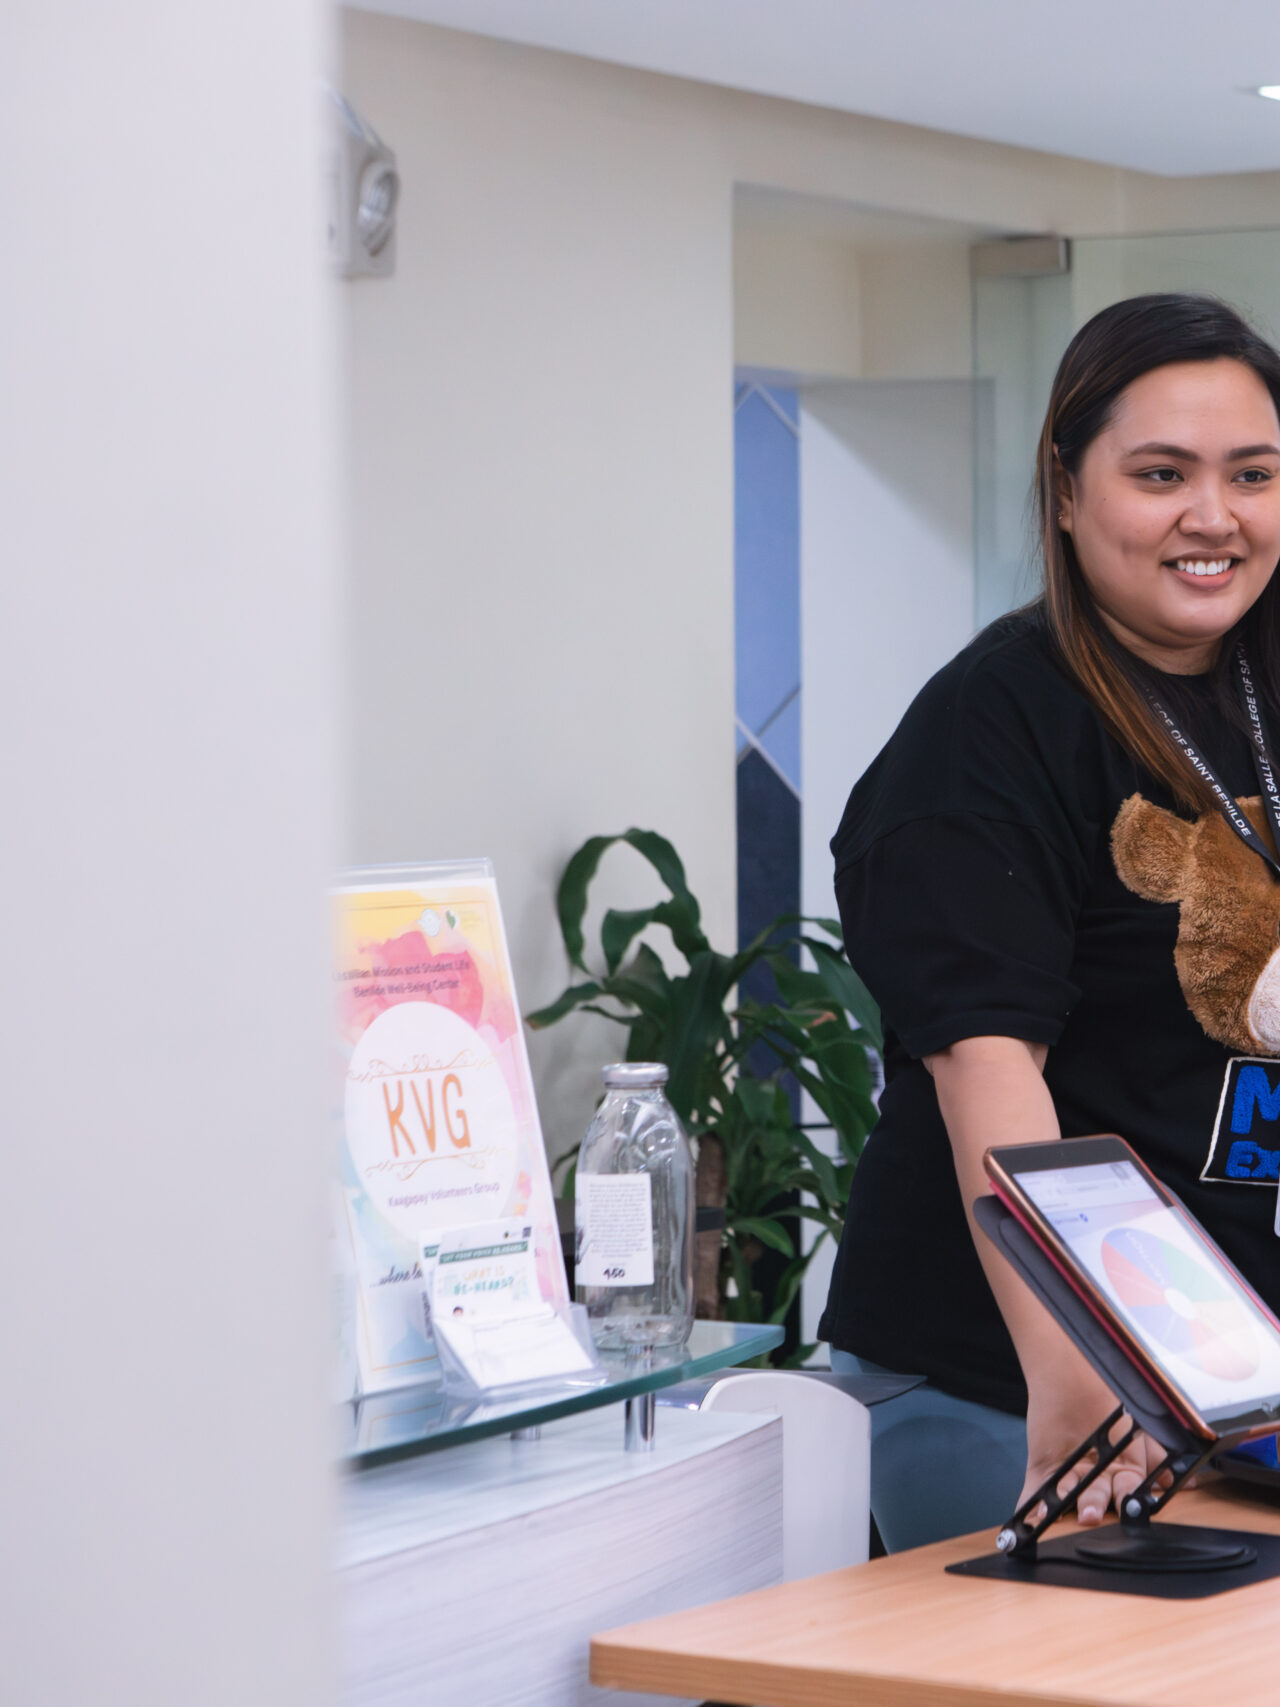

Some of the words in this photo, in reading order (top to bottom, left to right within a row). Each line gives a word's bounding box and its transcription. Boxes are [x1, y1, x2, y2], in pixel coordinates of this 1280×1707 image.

[1242, 678, 1254, 694] OF
[1184, 747, 1215, 782] SAINT
[1212, 784, 1252, 837] BENILDE
[382, 1073, 472, 1159] KVG
